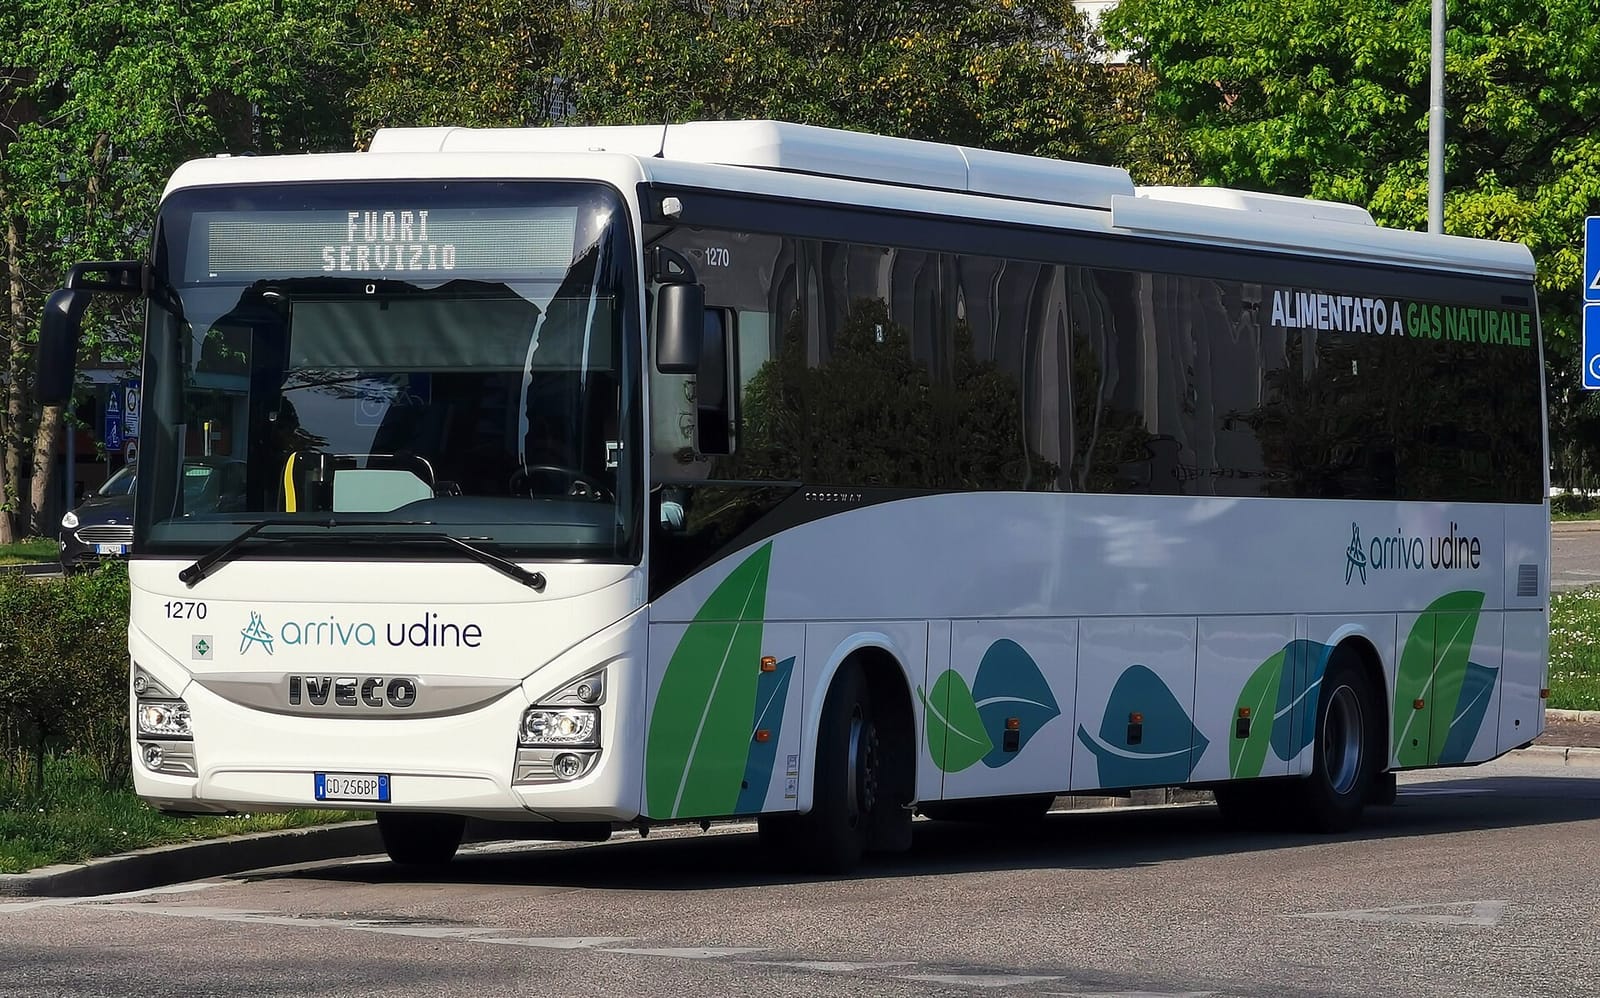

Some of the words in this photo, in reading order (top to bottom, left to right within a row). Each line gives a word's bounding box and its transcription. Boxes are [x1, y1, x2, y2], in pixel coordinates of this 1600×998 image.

[348, 210, 429, 242] FUORI
[322, 244, 456, 271] SERVIZIO
[705, 247, 730, 267] 1270
[1271, 290, 1387, 336] ALIMENTATO
[1390, 301, 1404, 336] A
[1407, 302, 1441, 341] GAS
[1445, 306, 1532, 347] NATURALE
[805, 492, 862, 502] CROSSWAY
[1370, 527, 1425, 570] arriva
[1430, 521, 1481, 570] udine
[164, 601, 208, 620] 1270
[281, 615, 376, 647] arriva
[386, 612, 482, 648] udine
[288, 675, 418, 708] IVECO
[326, 778, 340, 794] GD
[343, 779, 378, 795] 256BP
